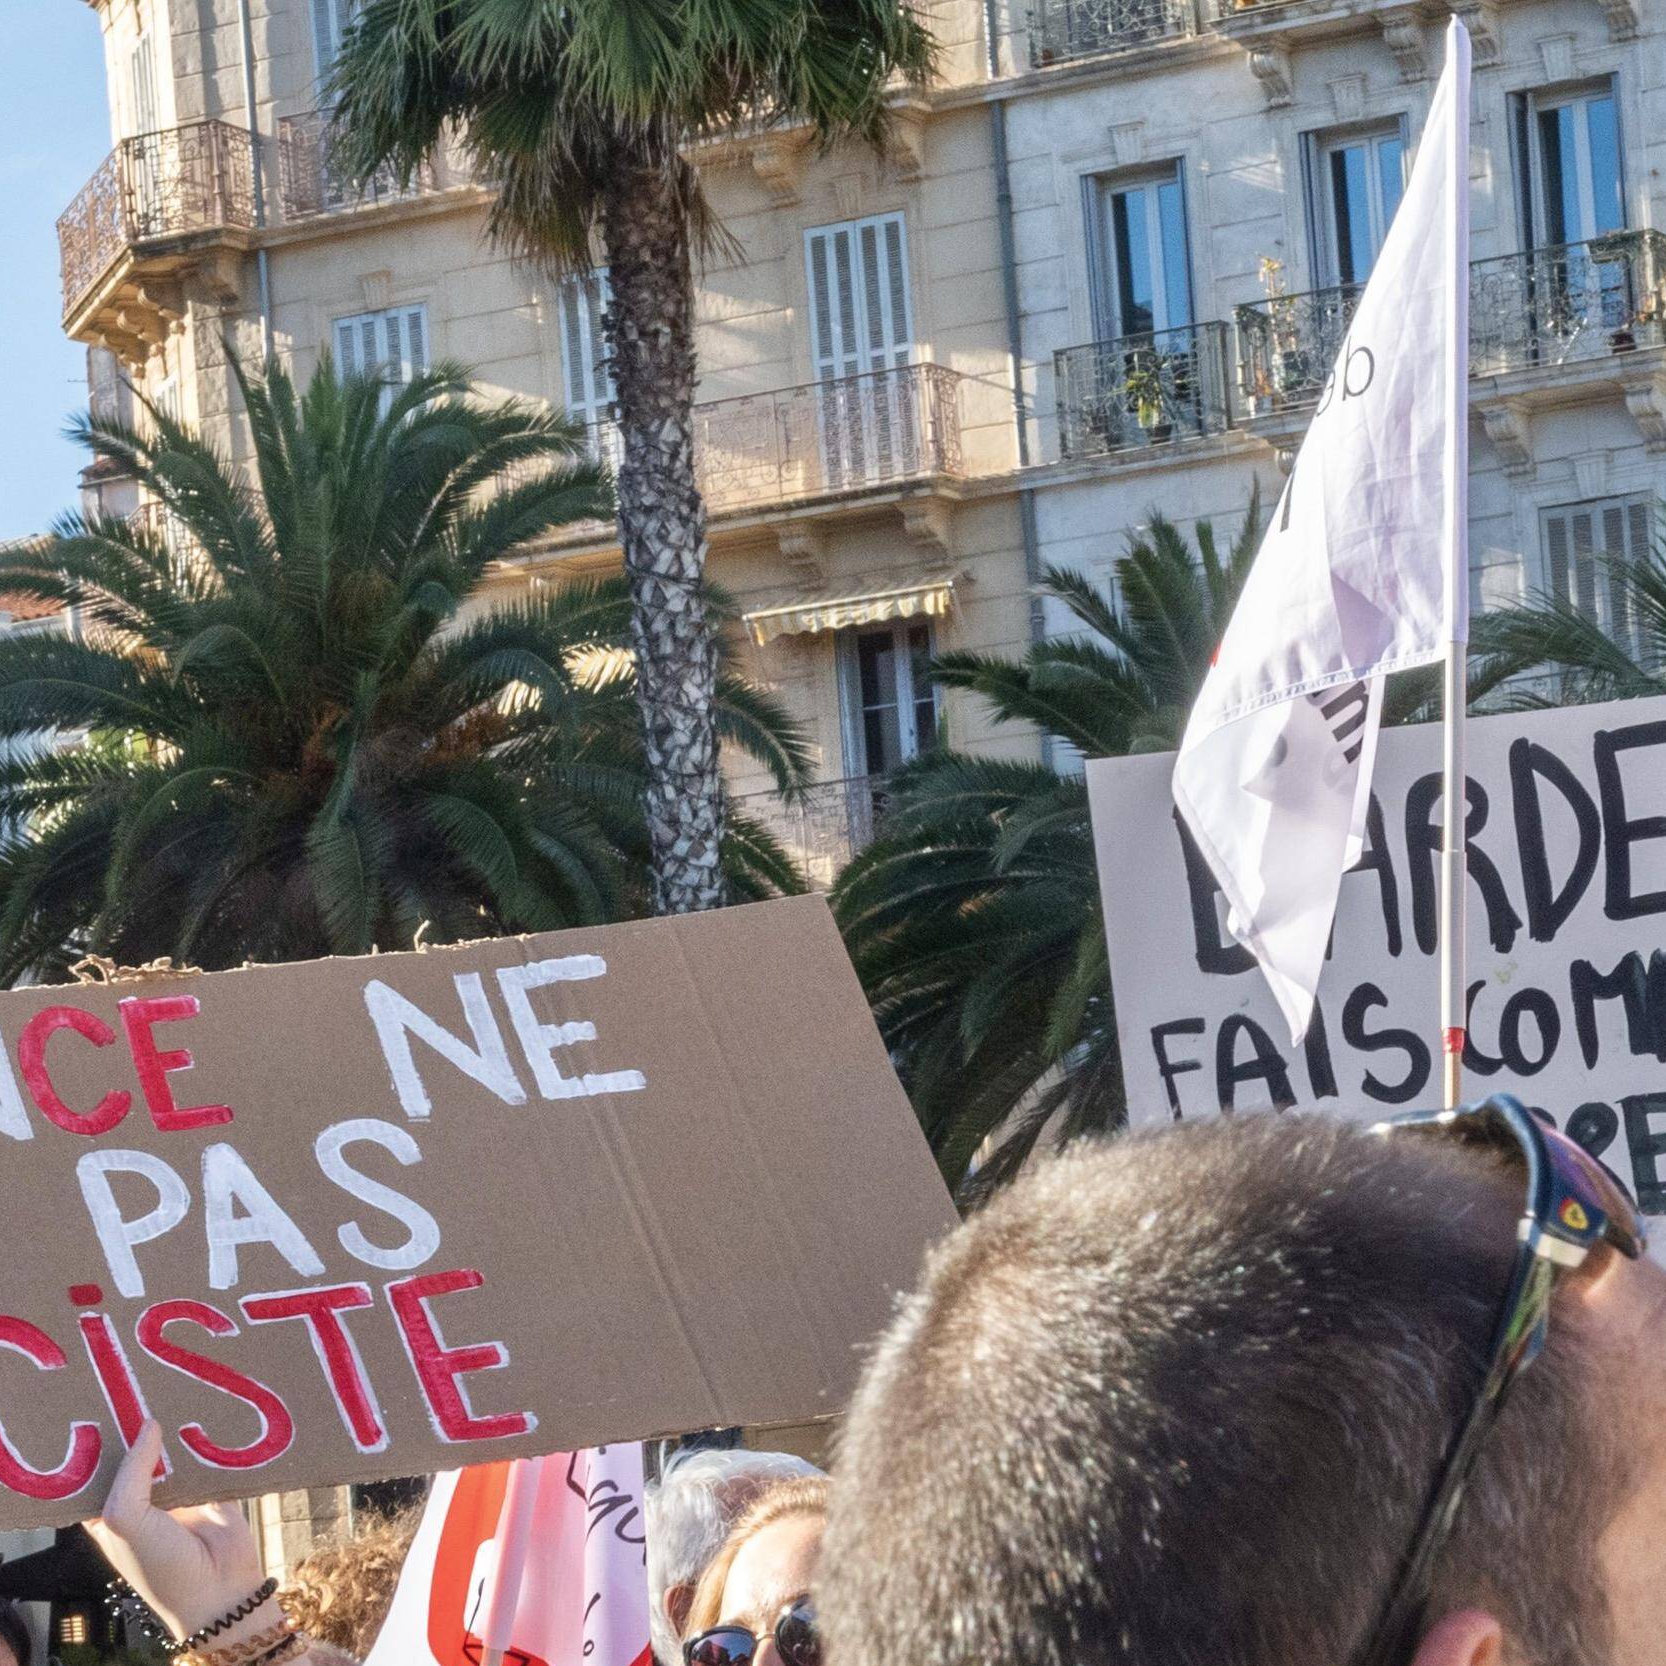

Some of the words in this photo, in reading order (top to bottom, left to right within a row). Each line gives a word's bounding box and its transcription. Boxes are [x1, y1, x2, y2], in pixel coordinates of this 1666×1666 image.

[363, 954, 646, 1120] NE
[1151, 980, 1432, 1119] FAIS
[76, 1116, 441, 1298] PAS
